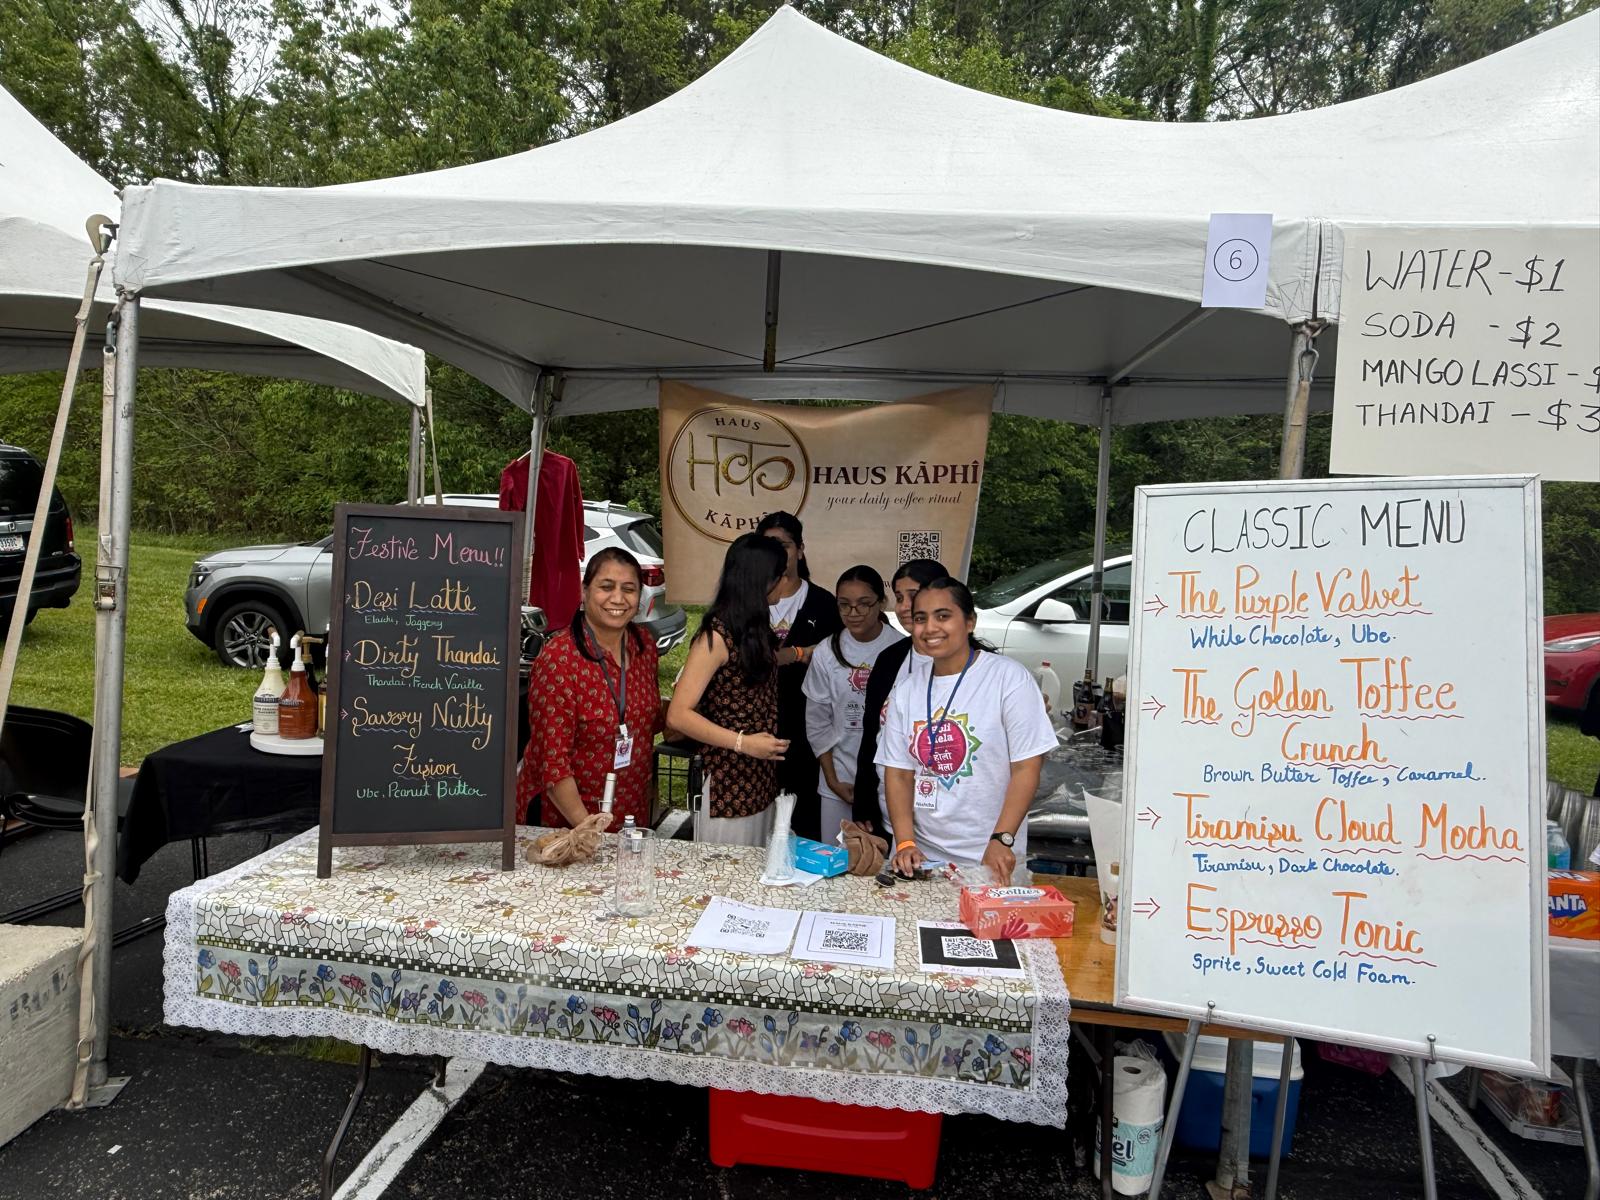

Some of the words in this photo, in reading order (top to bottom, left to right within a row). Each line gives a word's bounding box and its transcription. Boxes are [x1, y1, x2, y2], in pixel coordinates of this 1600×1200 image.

[1229, 249, 1243, 271] 6
[1361, 311, 1455, 340] SODA
[715, 417, 761, 431] HAUS
[1355, 401, 1496, 428] THANDAI
[812, 465, 887, 486] HAUS
[827, 494, 856, 511] your
[859, 491, 890, 511] daily
[893, 491, 925, 509] coffee
[928, 491, 962, 505] ritual
[1183, 503, 1333, 554] CLASSIC
[1360, 498, 1466, 548] MENU
[349, 526, 420, 560] Festive
[351, 580, 399, 611] Desi
[409, 578, 477, 612] Latte
[1168, 570, 1225, 614] The
[1234, 565, 1310, 632] Purple
[353, 635, 419, 679] Dirty
[431, 635, 501, 665] Thandai
[413, 675, 443, 690] French
[444, 673, 486, 691] Vanilla
[1171, 668, 1223, 722] The
[1230, 667, 1334, 738] Golden
[1339, 656, 1457, 715] Toffee
[352, 696, 422, 739] Savory
[431, 692, 493, 750] Nutty
[1281, 721, 1388, 764] Crunch
[392, 743, 460, 780] Fusion
[1203, 763, 1255, 783] Brown
[1261, 763, 1321, 783] Butter
[388, 781, 432, 798] Peanut
[437, 779, 488, 799] Butter
[1172, 792, 1303, 848] Tiramisu
[1315, 797, 1402, 845] Cloud
[1414, 802, 1524, 853] Mocha
[1279, 857, 1318, 874] Dark
[1548, 894, 1587, 911] ANTA
[1186, 882, 1323, 955] Espresso
[1332, 891, 1424, 954] Tonic
[1255, 956, 1305, 978] Sweet
[1312, 959, 1347, 981] Cold
